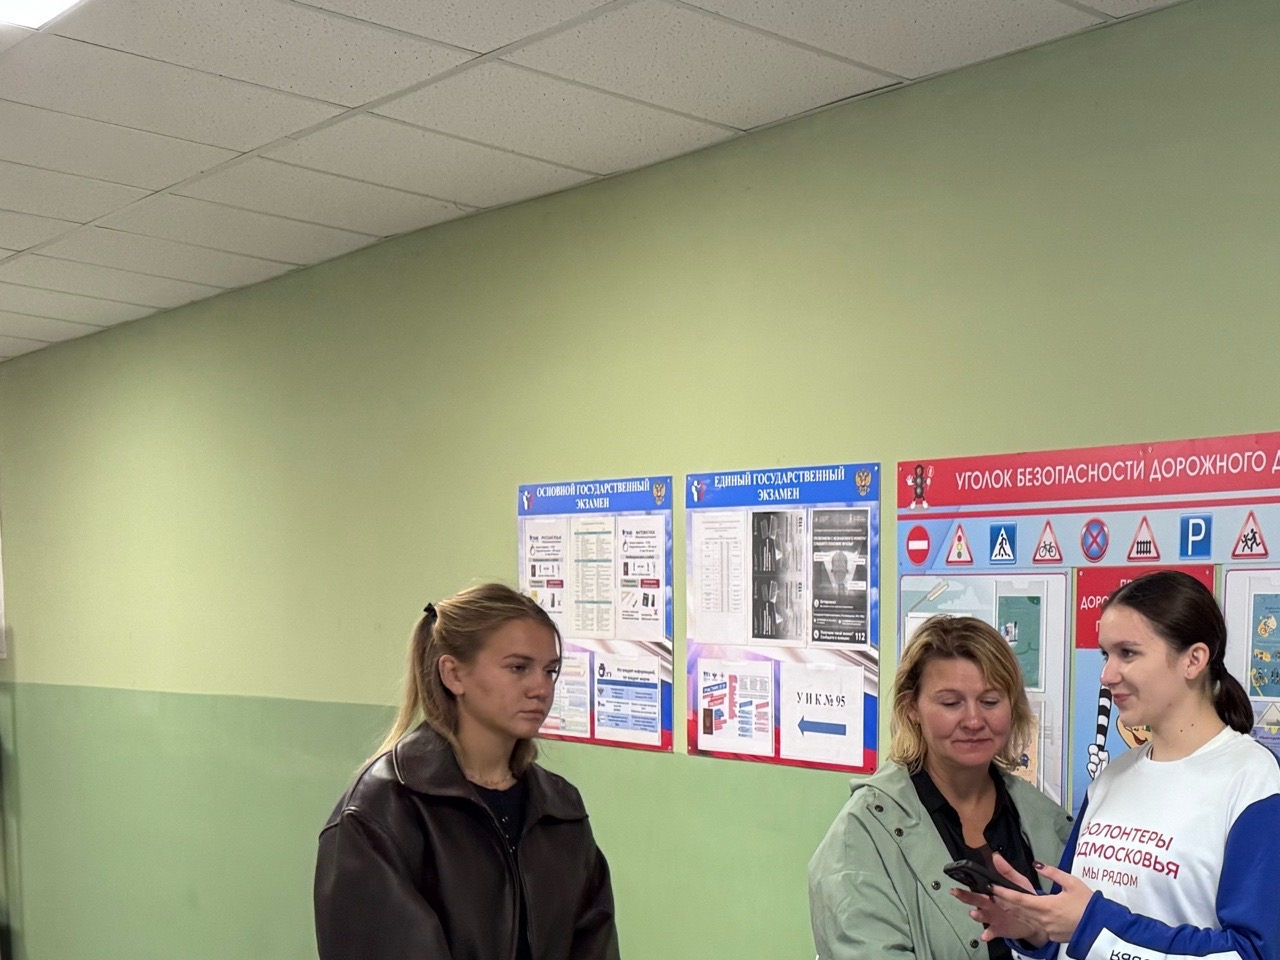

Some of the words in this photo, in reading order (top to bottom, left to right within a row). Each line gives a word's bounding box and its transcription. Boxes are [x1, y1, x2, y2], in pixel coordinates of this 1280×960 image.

[714, 472, 751, 488] ЕДИННЫЙ
[753, 466, 845, 485] ГОСУДАРСТВЕННЫЙ
[955, 468, 1013, 491] УГОЛОК
[1017, 459, 1145, 487] БЕЗОПАСНОСТИ
[1149, 449, 1267, 482] ДОРОЖНОГО
[536, 483, 576, 497] ОСНОВНОЙ
[576, 479, 650, 496] ГОСУДАРСТВЕННЫЙ
[757, 487, 800, 501] ЭКЗАМЕН
[575, 497, 610, 509] ЭКЗАМЕН
[855, 632, 866, 641] 112
[823, 694, 834, 707] №
[836, 695, 846, 708] 95
[1082, 866, 1099, 880] МЫ
[1101, 868, 1138, 888] РЯДОМ
